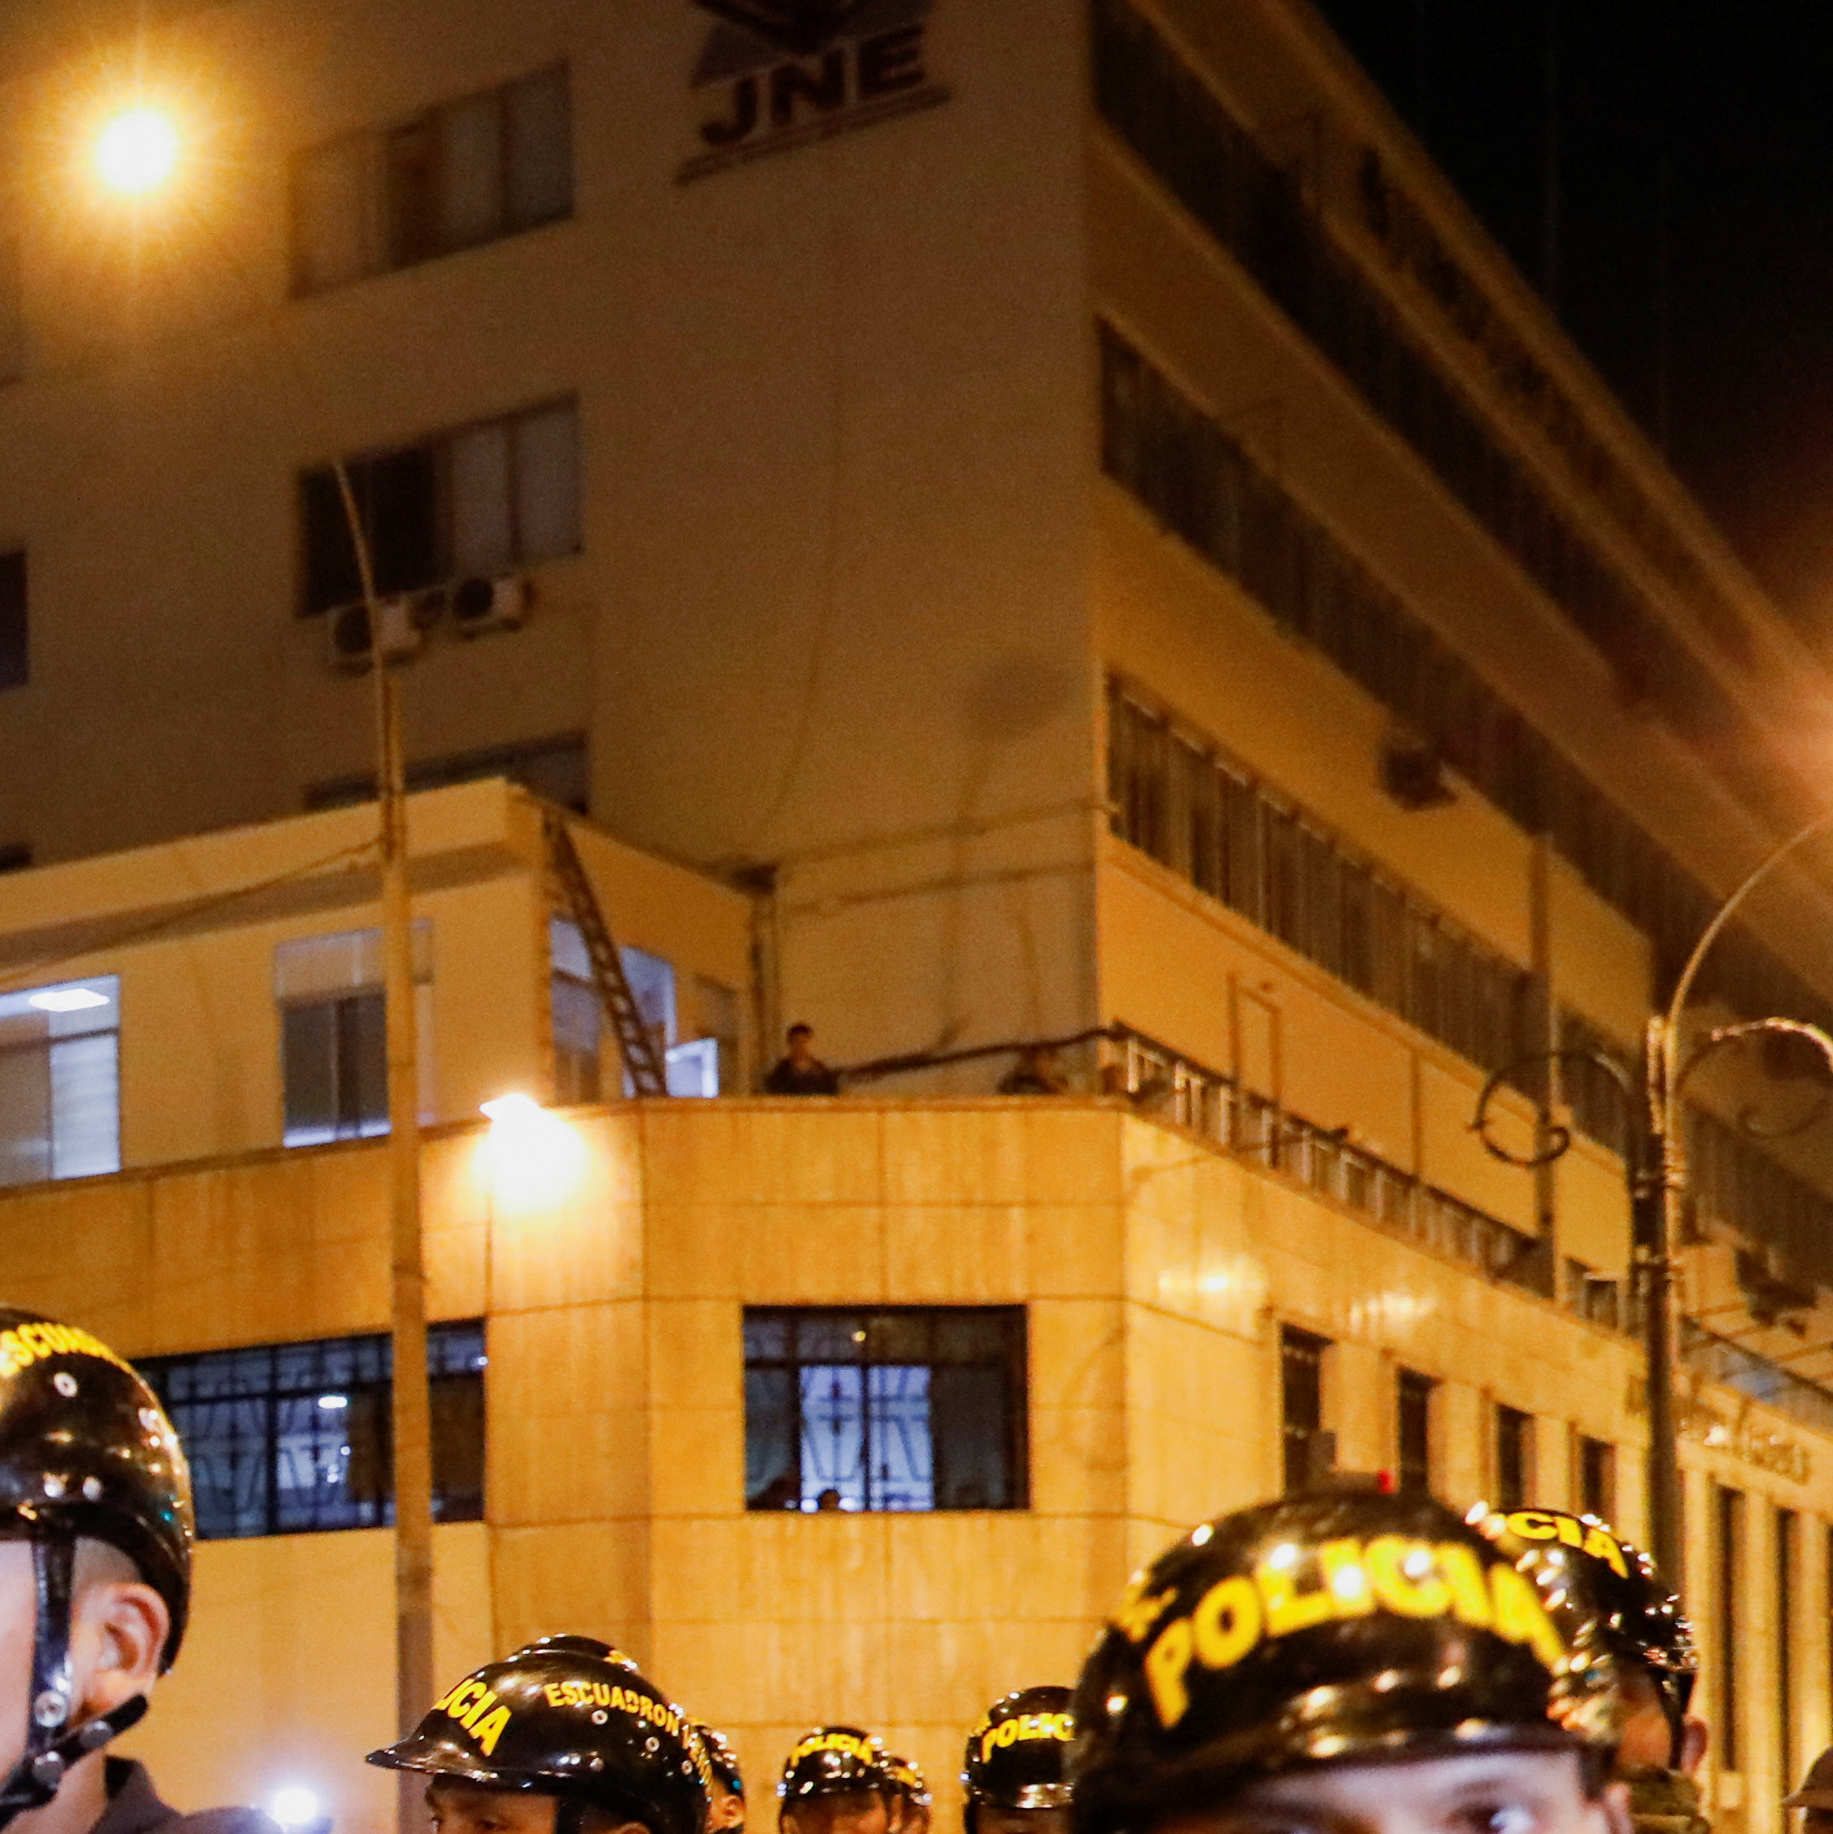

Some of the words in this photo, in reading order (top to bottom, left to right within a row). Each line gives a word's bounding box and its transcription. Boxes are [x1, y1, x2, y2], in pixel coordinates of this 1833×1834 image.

[699, 22, 925, 147] JNE
[1145, 1535, 1565, 1728] POLICIA
[543, 1680, 681, 1737] ESCUADRON
[982, 1712, 1075, 1764] POLIC
